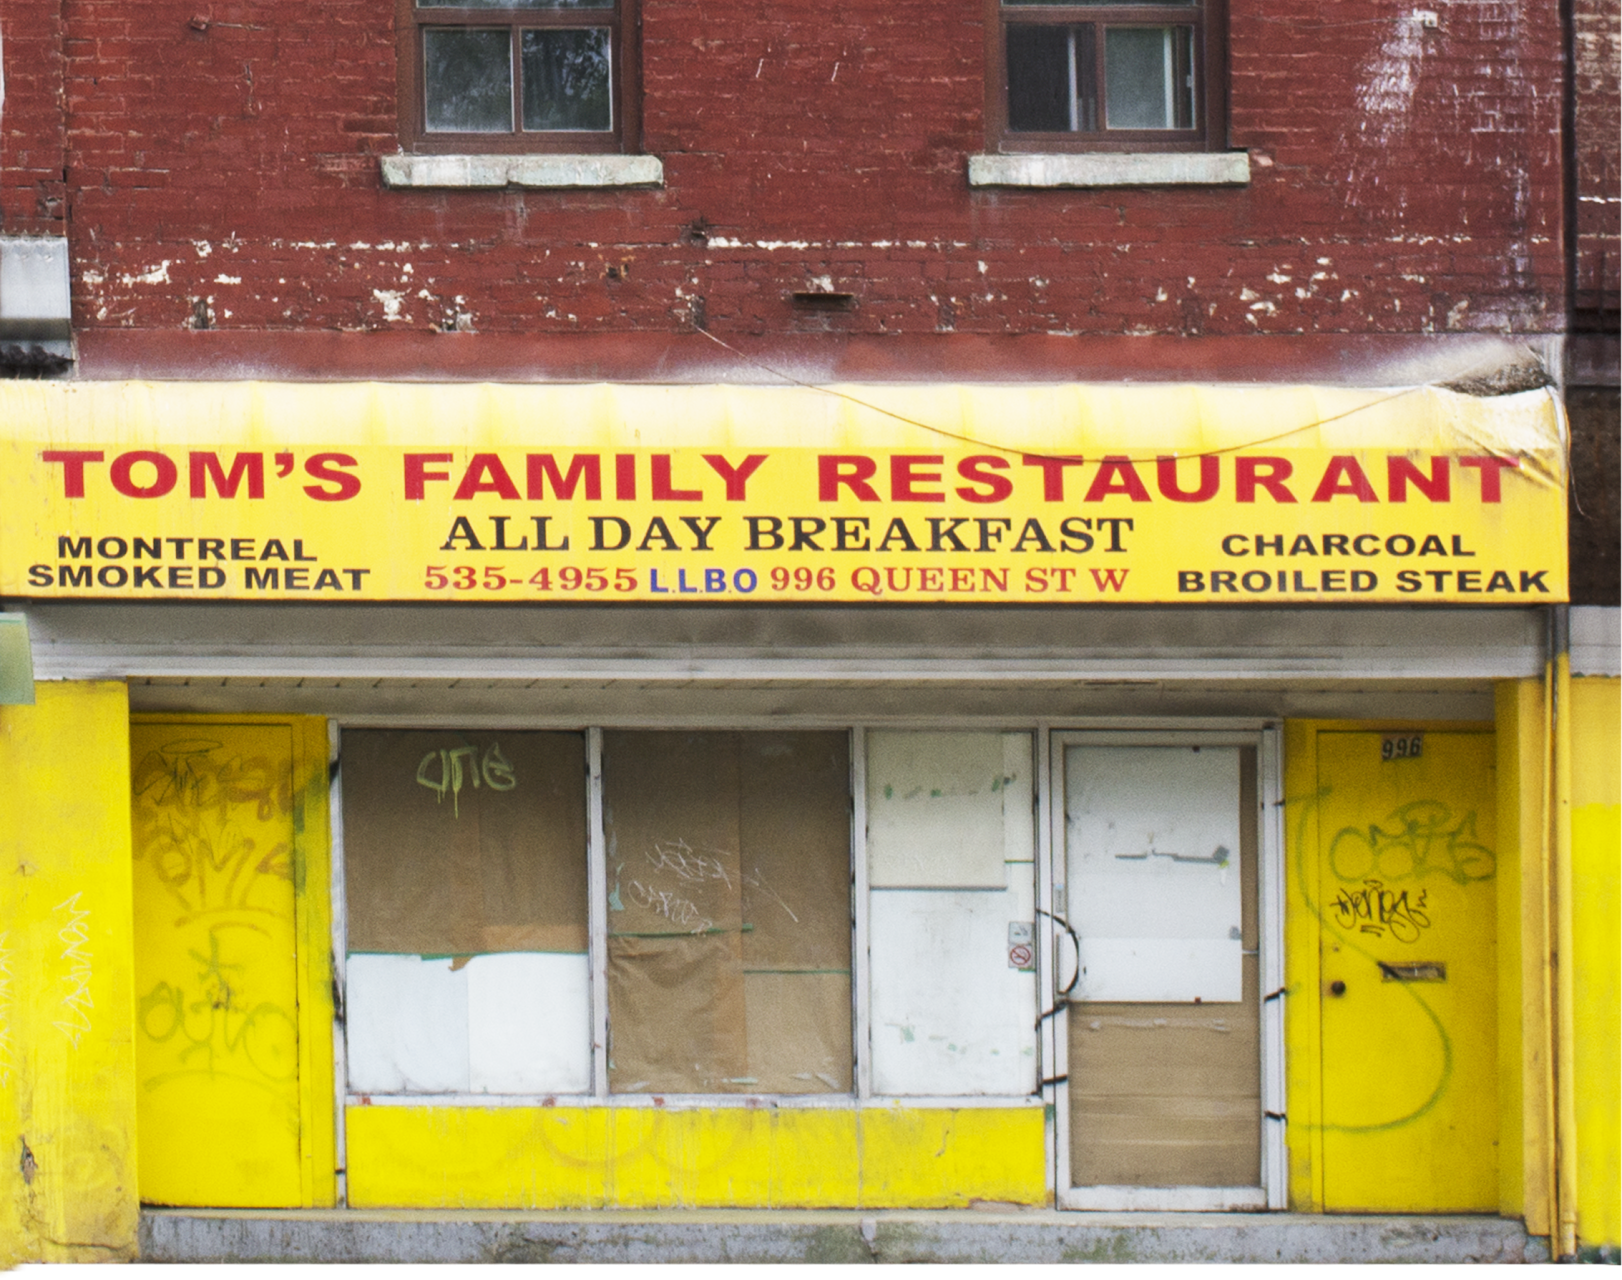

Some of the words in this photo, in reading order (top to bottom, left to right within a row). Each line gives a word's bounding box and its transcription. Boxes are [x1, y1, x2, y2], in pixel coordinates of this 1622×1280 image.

[42, 450, 362, 502] TOM'S
[403, 452, 769, 502] FAMILY
[817, 452, 1521, 504] RESTAURANT
[439, 515, 570, 551] ALL
[587, 516, 721, 552] DAY
[742, 515, 1134, 554] BREAKFAST
[1221, 533, 1476, 557] CHARCOAL
[57, 535, 318, 562] MONTREAL
[28, 564, 227, 589] SMOKED
[244, 566, 371, 591] MEAT
[424, 565, 638, 592] 535-4955
[770, 566, 836, 591] 996
[851, 566, 1009, 596] QUEEN
[1025, 567, 1076, 593] ST
[1089, 568, 1129, 593] W
[1177, 569, 1378, 593] BROILED
[1396, 569, 1550, 593] STEAK
[1382, 737, 1421, 759] 996
